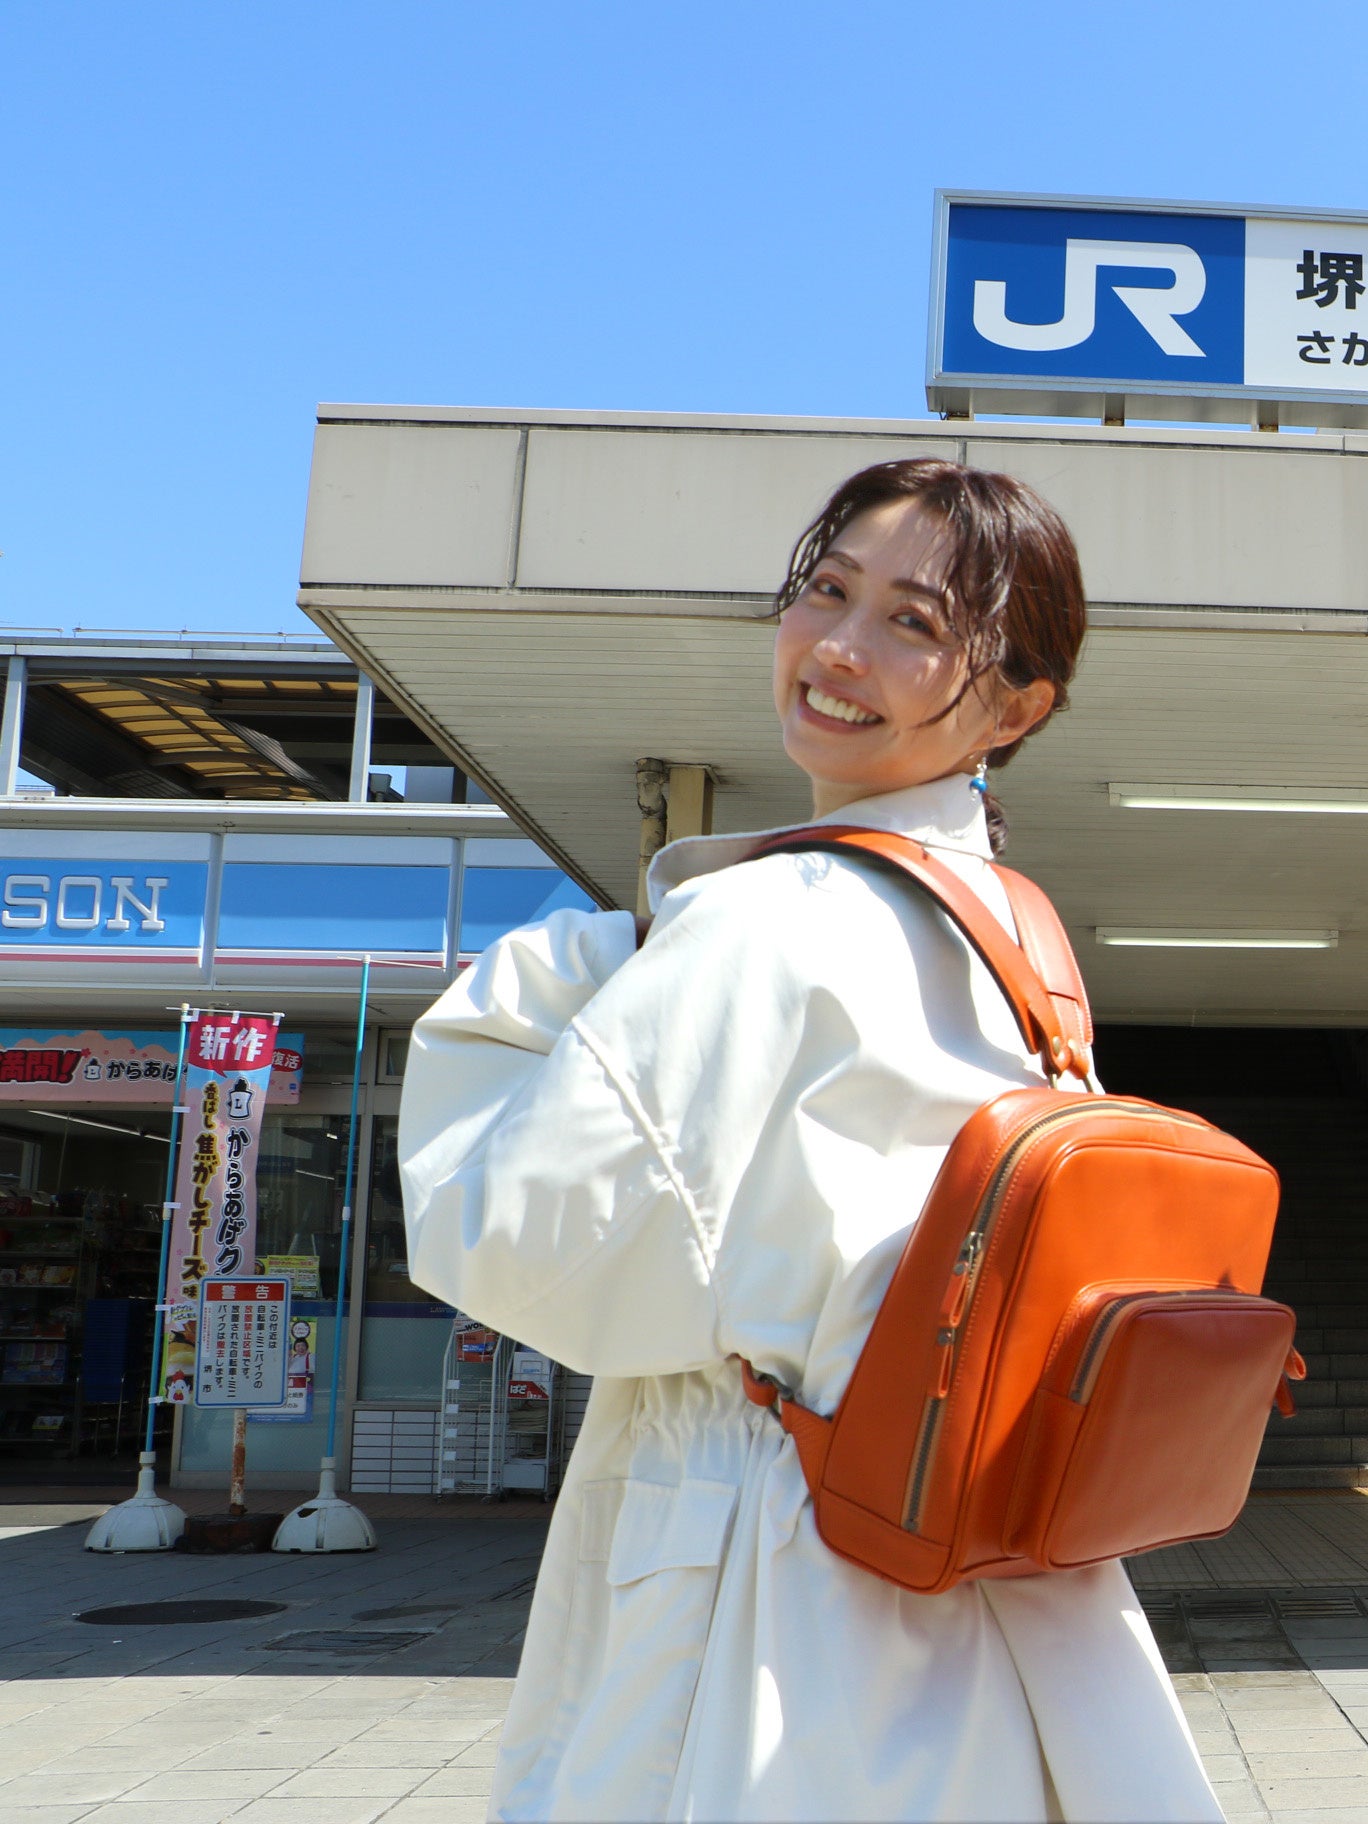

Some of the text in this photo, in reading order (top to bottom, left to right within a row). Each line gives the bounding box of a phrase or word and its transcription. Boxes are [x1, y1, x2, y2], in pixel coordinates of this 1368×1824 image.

[973, 238, 1206, 358] JR
[1, 874, 169, 932] SON
[199, 1025, 267, 1062] 新作
[272, 1051, 299, 1069] 復活
[216, 1129, 249, 1276] からあげク
[221, 1284, 270, 1300] 警告
[268, 1305, 279, 1349] この付近は
